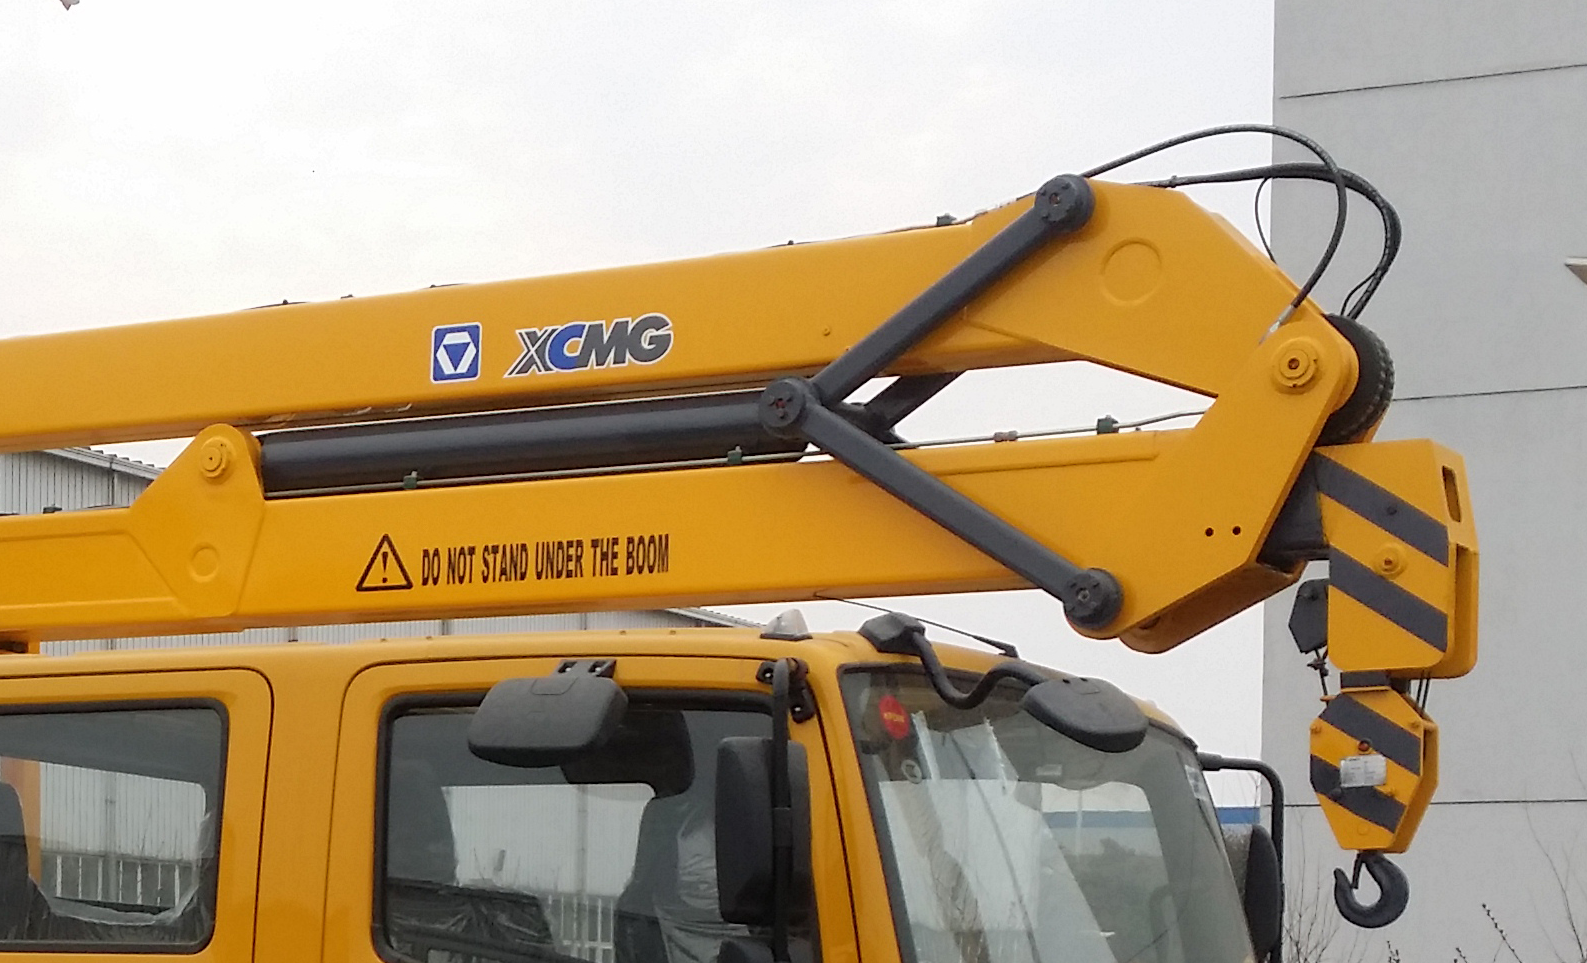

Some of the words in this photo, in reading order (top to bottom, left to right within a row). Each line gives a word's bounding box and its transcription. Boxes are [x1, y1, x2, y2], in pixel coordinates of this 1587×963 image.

[505, 313, 673, 377] XCMG
[421, 547, 441, 586] DO
[447, 545, 476, 585] NOT
[482, 542, 529, 584] STAND
[535, 539, 584, 580] UNDER
[591, 537, 619, 577] THE
[626, 533, 669, 575] BOOM
